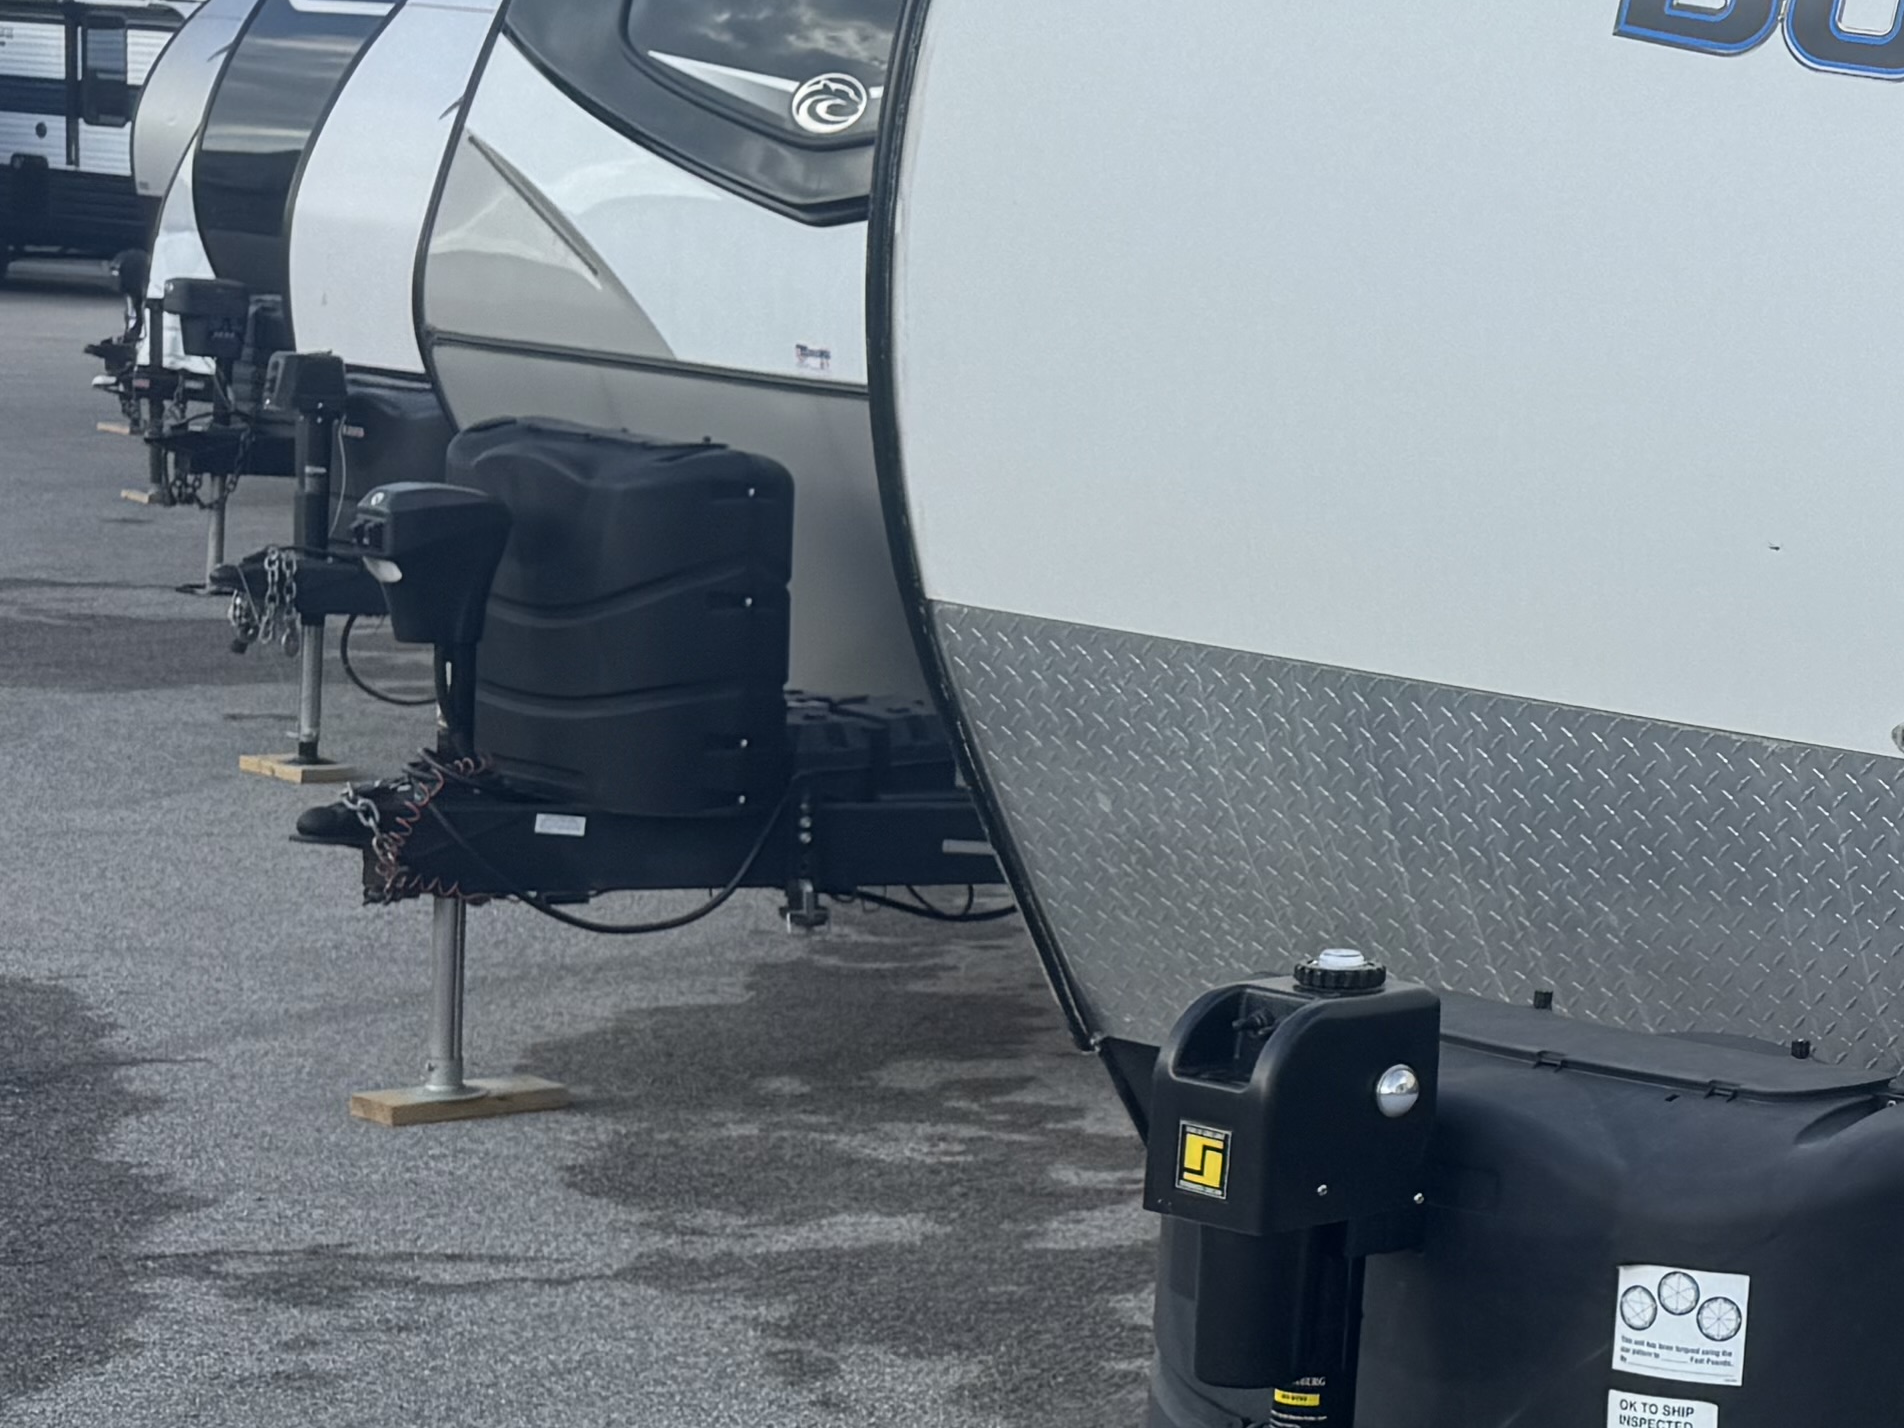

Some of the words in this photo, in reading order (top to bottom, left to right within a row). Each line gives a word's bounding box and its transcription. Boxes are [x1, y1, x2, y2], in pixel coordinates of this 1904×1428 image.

[1619, 1399, 1637, 1412] OK
[1641, 1402, 1658, 1415] TO
[1662, 1404, 1694, 1417] SHIP
